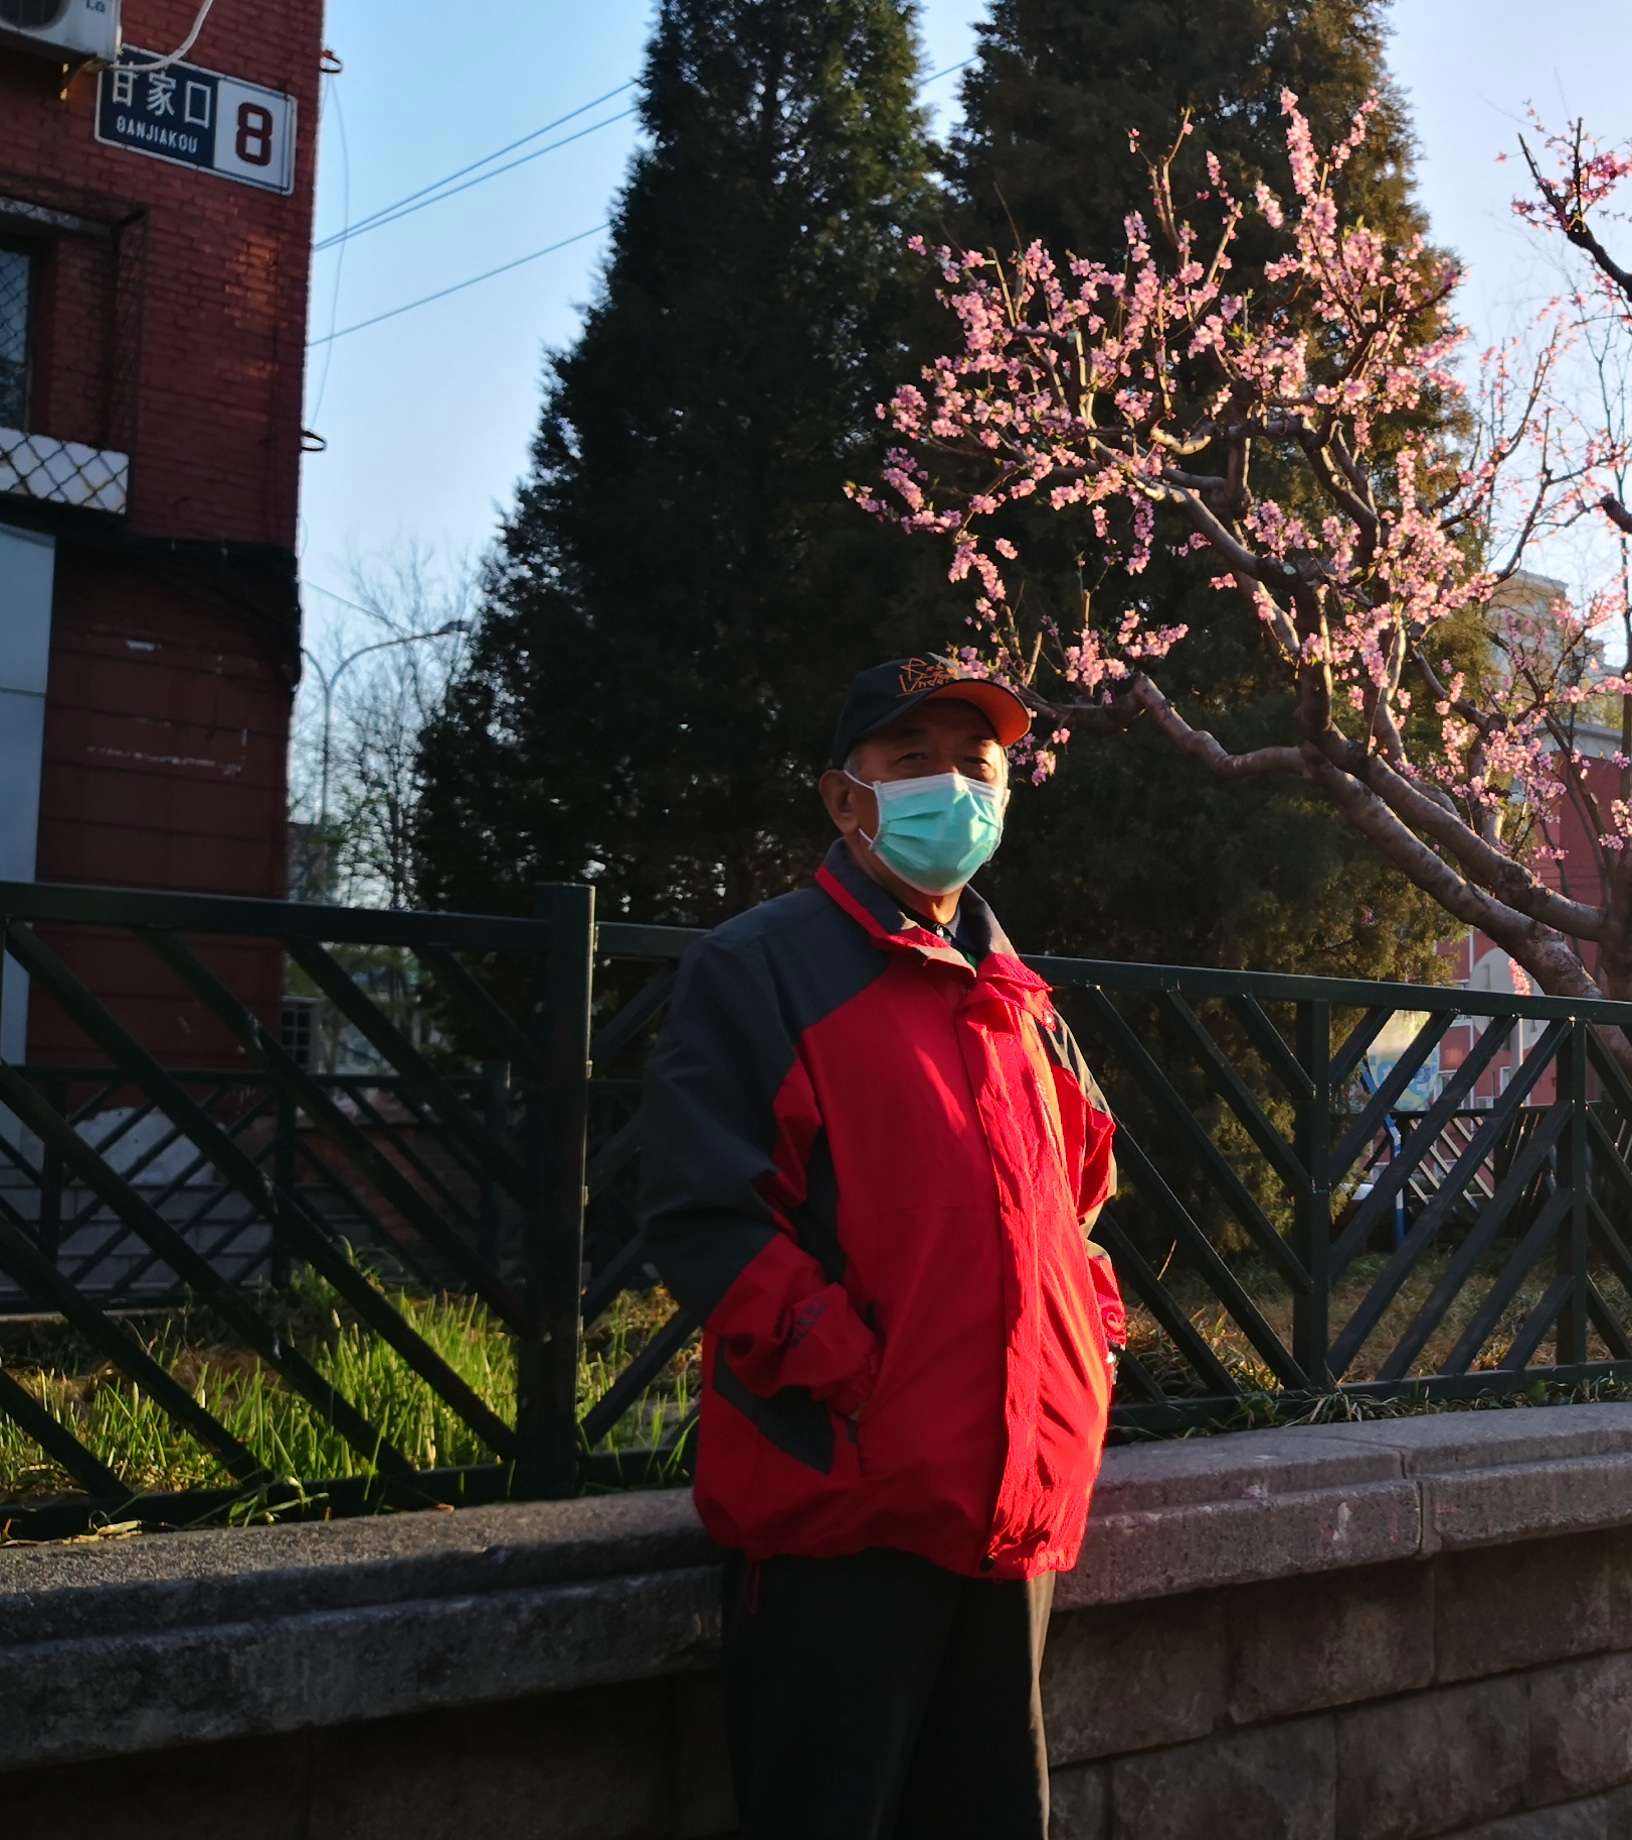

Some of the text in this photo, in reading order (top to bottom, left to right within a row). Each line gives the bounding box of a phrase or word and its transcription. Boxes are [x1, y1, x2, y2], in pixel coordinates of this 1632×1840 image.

[111, 60, 213, 130] 甘家口
[116, 115, 199, 154] GANJIAKOU
[235, 101, 273, 167] 8
